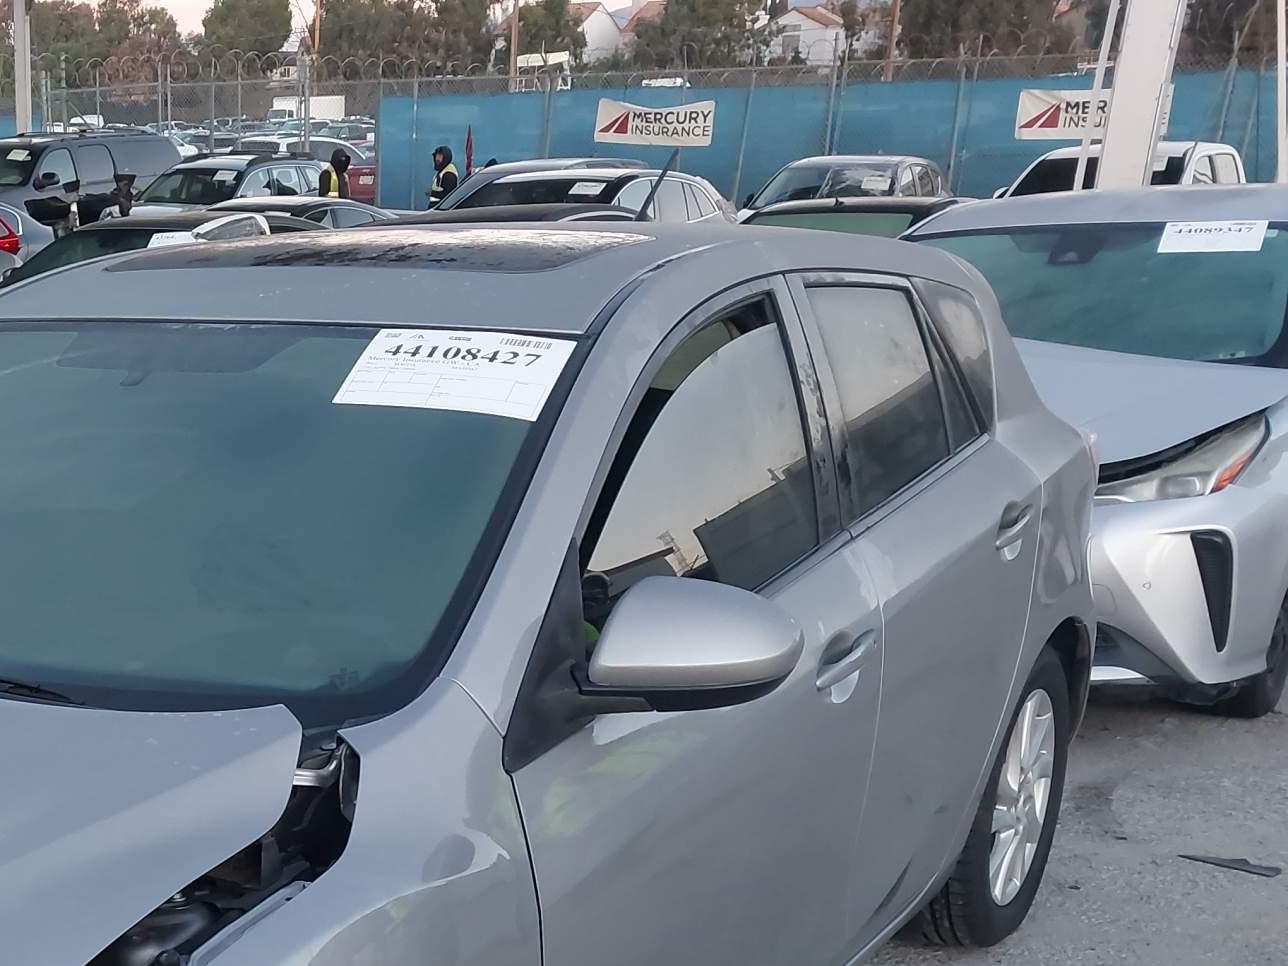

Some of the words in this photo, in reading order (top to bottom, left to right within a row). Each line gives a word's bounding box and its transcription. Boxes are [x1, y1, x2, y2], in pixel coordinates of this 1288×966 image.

[632, 110, 713, 125] MERCURY
[631, 124, 711, 137] INSURANCE
[383, 342, 543, 367] 44108427
